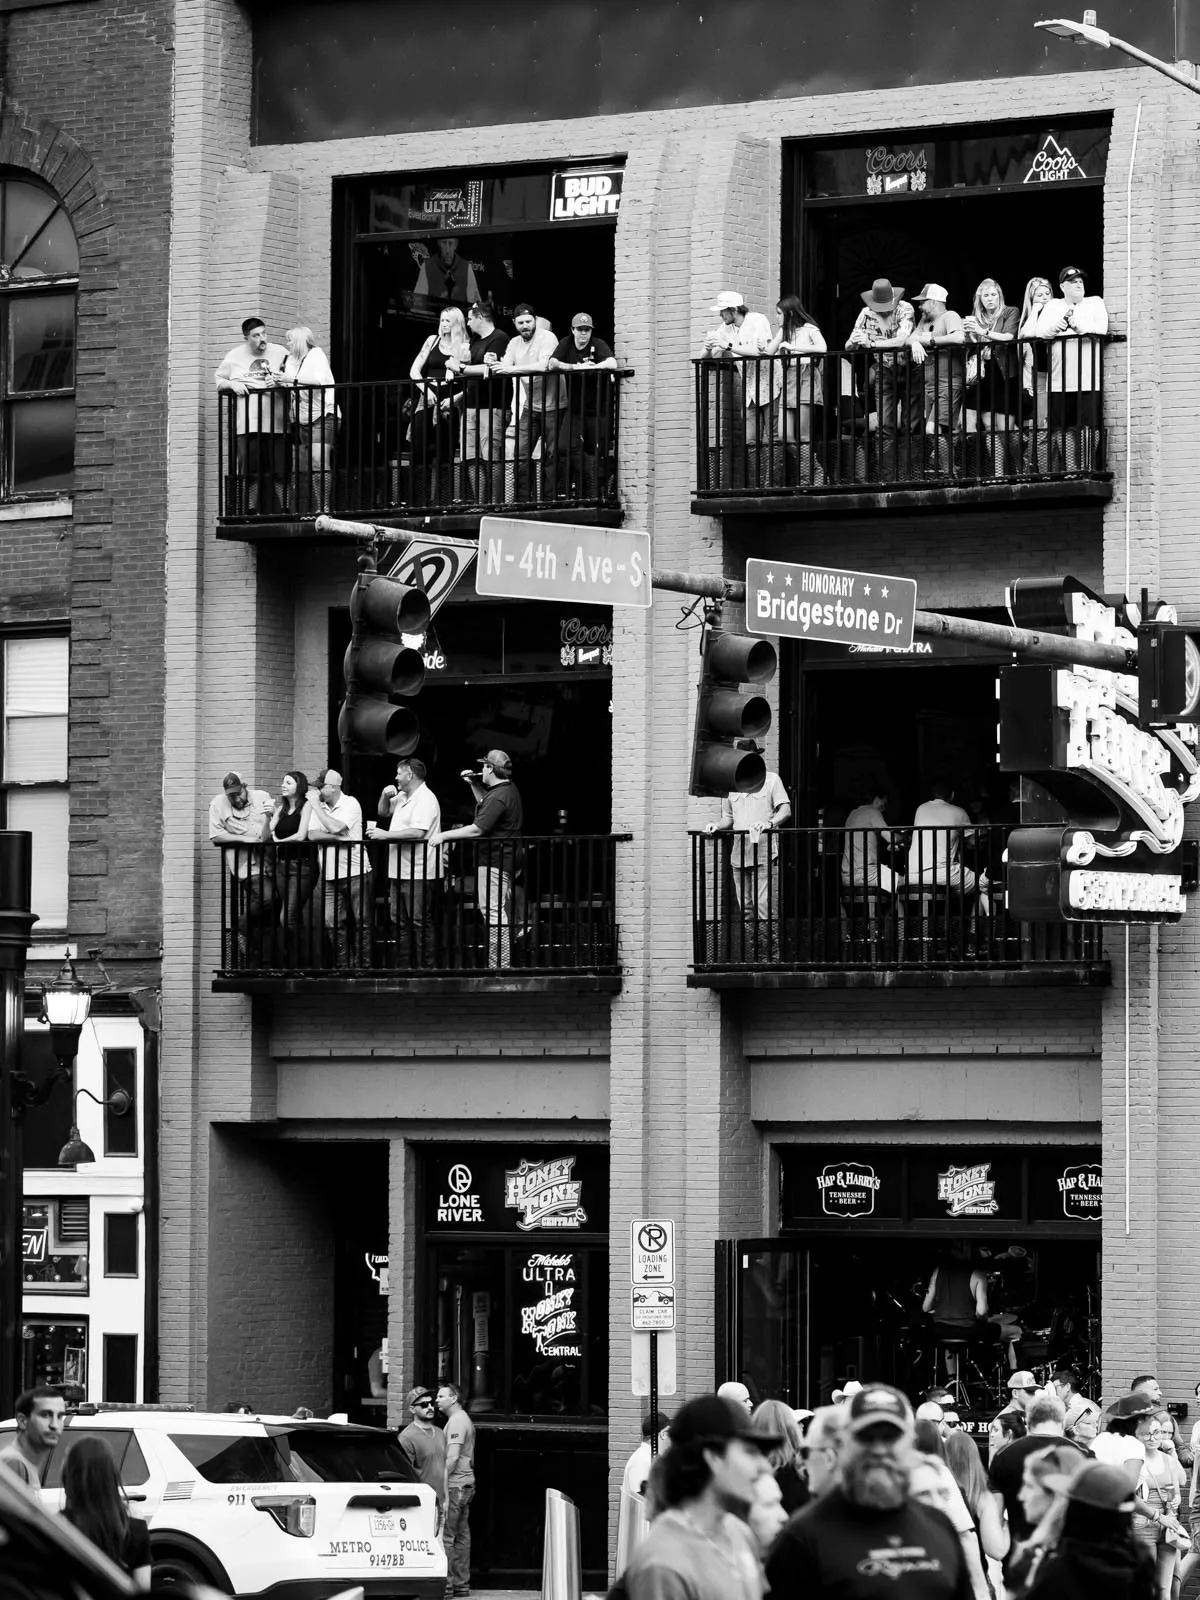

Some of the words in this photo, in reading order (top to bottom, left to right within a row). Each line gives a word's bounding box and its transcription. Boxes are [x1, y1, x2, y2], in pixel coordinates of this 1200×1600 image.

[865, 146, 927, 174] Coors
[1032, 150, 1078, 172] Coors
[1040, 169, 1069, 181] LIGHT
[565, 176, 612, 198] BUD
[423, 200, 466, 213] ULTRA
[487, 538, 556, 580] N-4th
[802, 571, 855, 598] HONORARY
[757, 589, 880, 632] Bridgestone
[884, 612, 903, 635] Dr
[506, 1157, 574, 1205] HONKY
[837, 1171, 847, 1188] &
[940, 1165, 989, 1197] HONKY
[1078, 1173, 1089, 1190] &
[440, 1195, 480, 1208] LONE
[829, 1191, 867, 1199] TENNESSEE
[949, 1183, 993, 1212] TONK
[1070, 1193, 1102, 1201] TENNESS
[520, 1183, 580, 1225] TONK
[438, 1209, 482, 1222] RIVER
[541, 1217, 579, 1227] CENTRAL
[528, 1254, 573, 1267] Michelob
[638, 1255, 667, 1263] LOADING
[523, 1268, 576, 1281] ULTRA
[645, 1264, 662, 1273] ZONE
[521, 1288, 574, 1334] HONKY
[532, 1311, 577, 1353] TONK
[542, 1346, 582, 1356] CENTRAL
[228, 1494, 246, 1506] 911
[330, 1541, 372, 1553] METRO
[400, 1540, 430, 1552] POLICE
[369, 1554, 405, 1566] 9147BB
